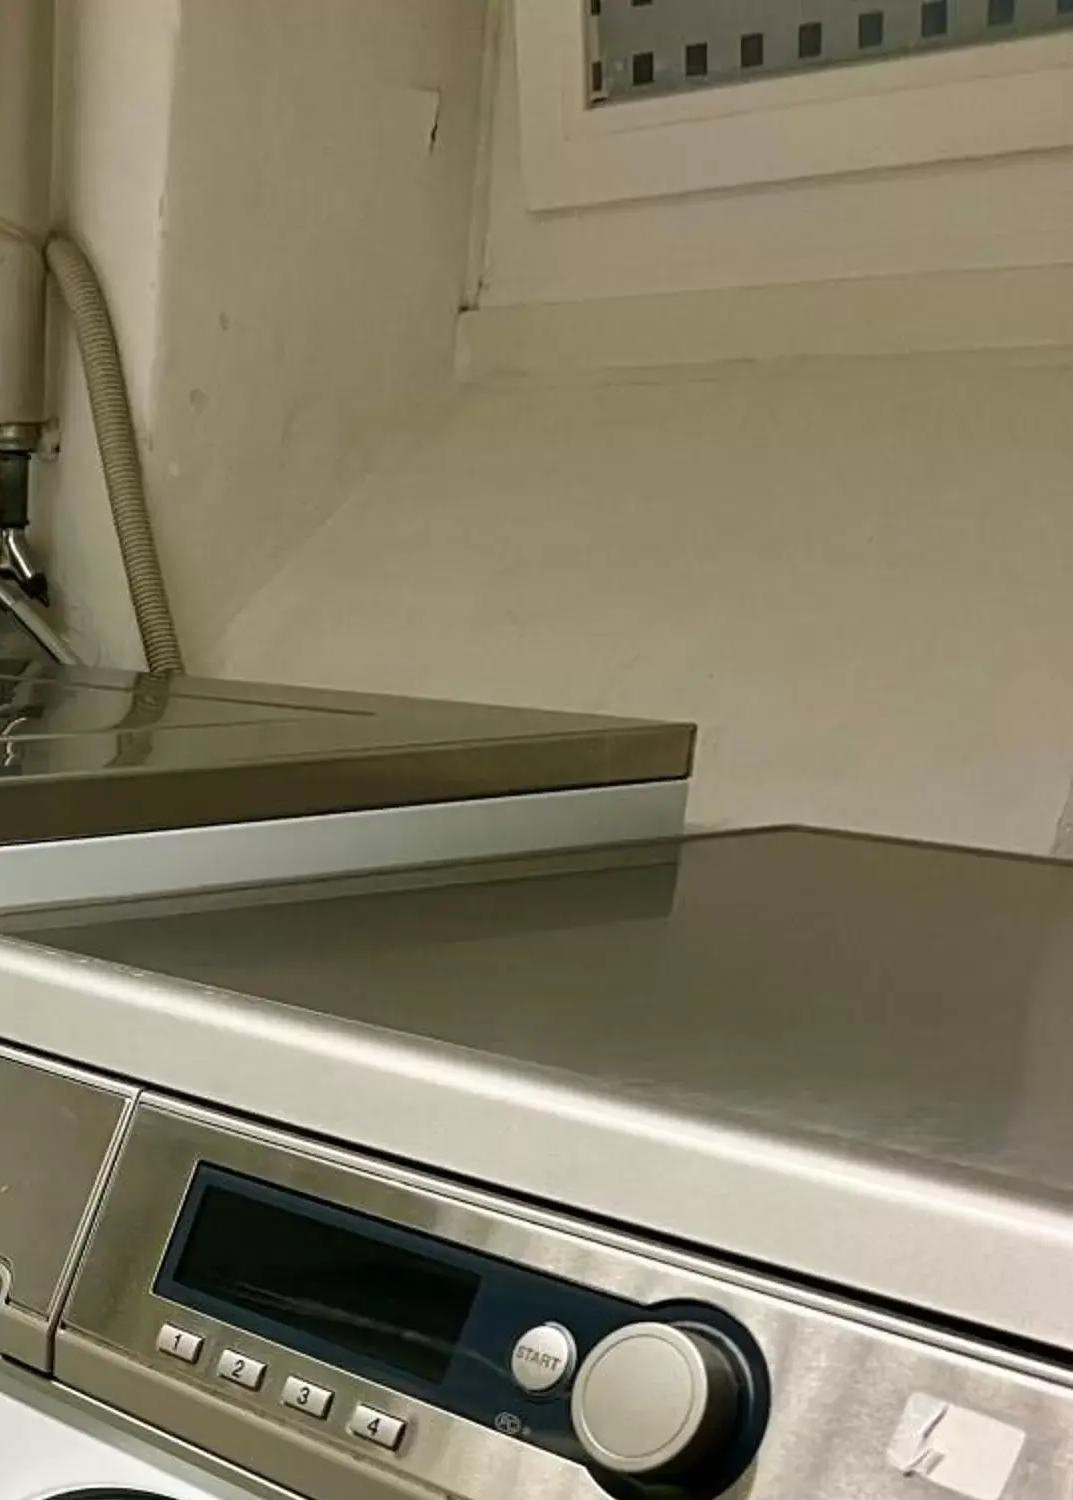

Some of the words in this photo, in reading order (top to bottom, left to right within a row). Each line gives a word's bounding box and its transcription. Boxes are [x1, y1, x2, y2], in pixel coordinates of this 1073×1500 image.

[174, 1333, 183, 1350] 1
[516, 1345, 561, 1371] START
[231, 1359, 245, 1379] 2
[296, 1386, 310, 1405] 3
[367, 1417, 381, 1437] 4
